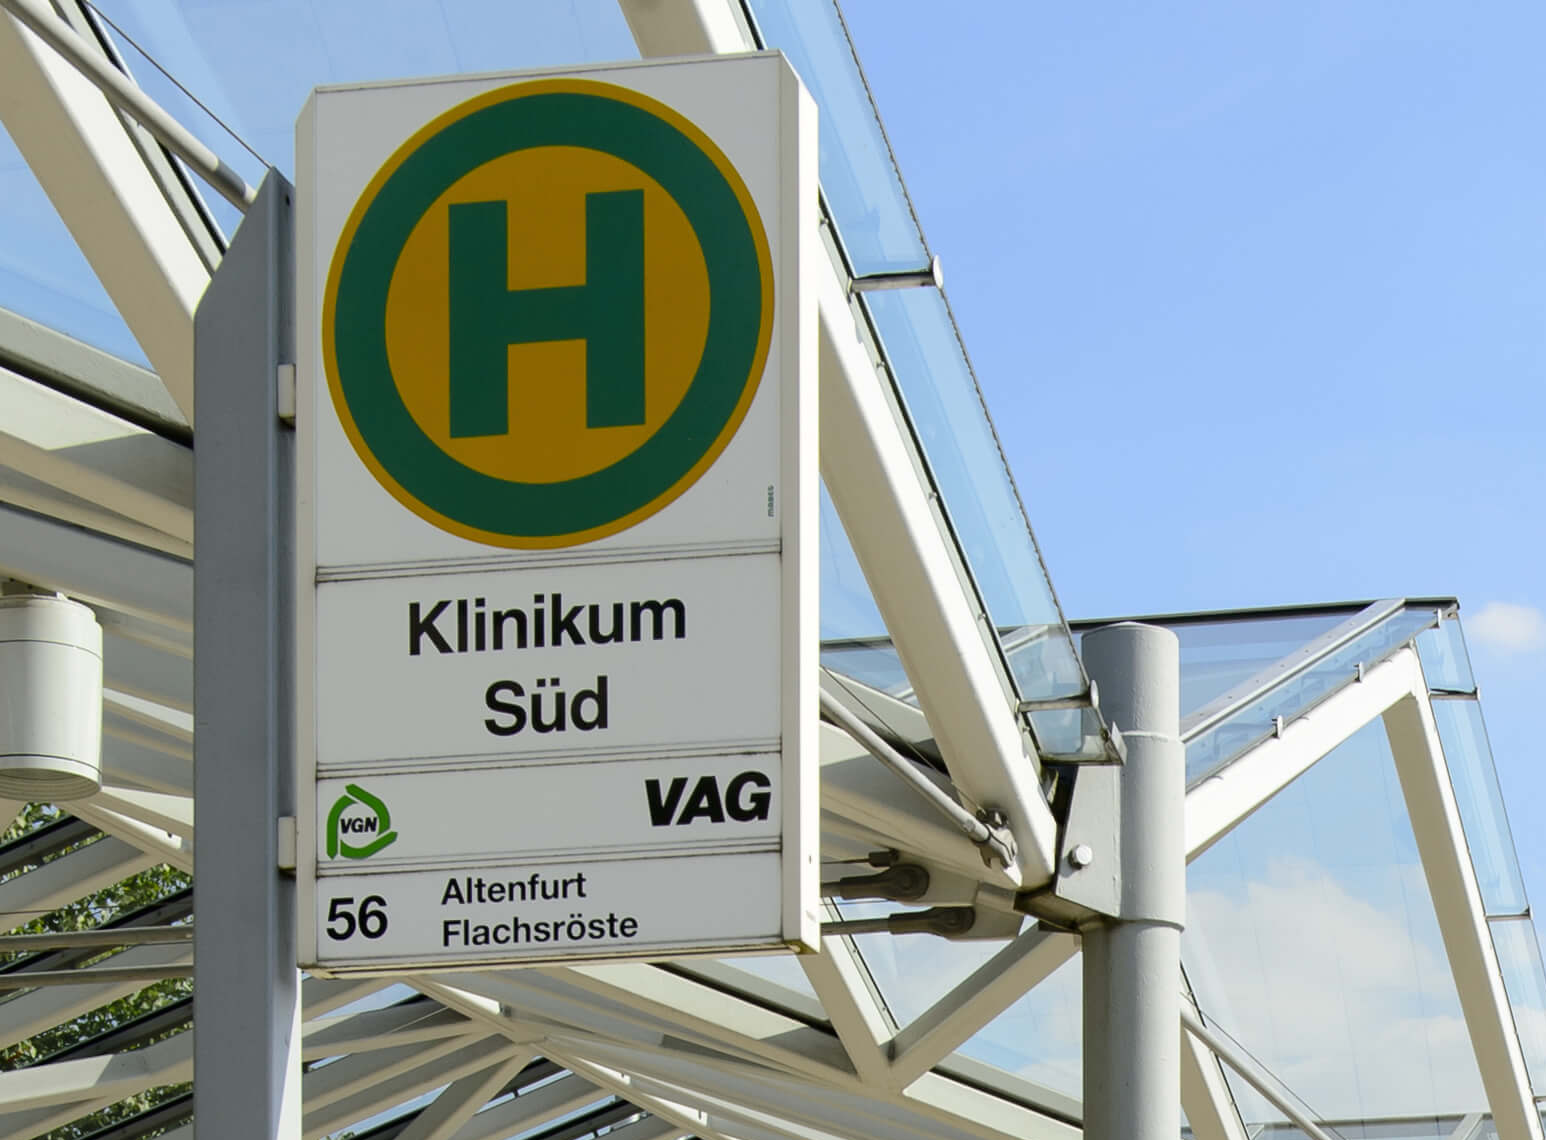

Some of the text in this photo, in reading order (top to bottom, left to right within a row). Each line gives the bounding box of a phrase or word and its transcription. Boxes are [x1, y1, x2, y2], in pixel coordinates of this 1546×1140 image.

[449, 189, 645, 438] H
[407, 593, 687, 656] Klinikum
[484, 676, 609, 736] Süd
[645, 771, 772, 827] VAG
[340, 816, 378, 835] VGN
[441, 872, 586, 906] Altenfurt
[326, 895, 388, 941] 56
[442, 912, 639, 947] Flachsröste
